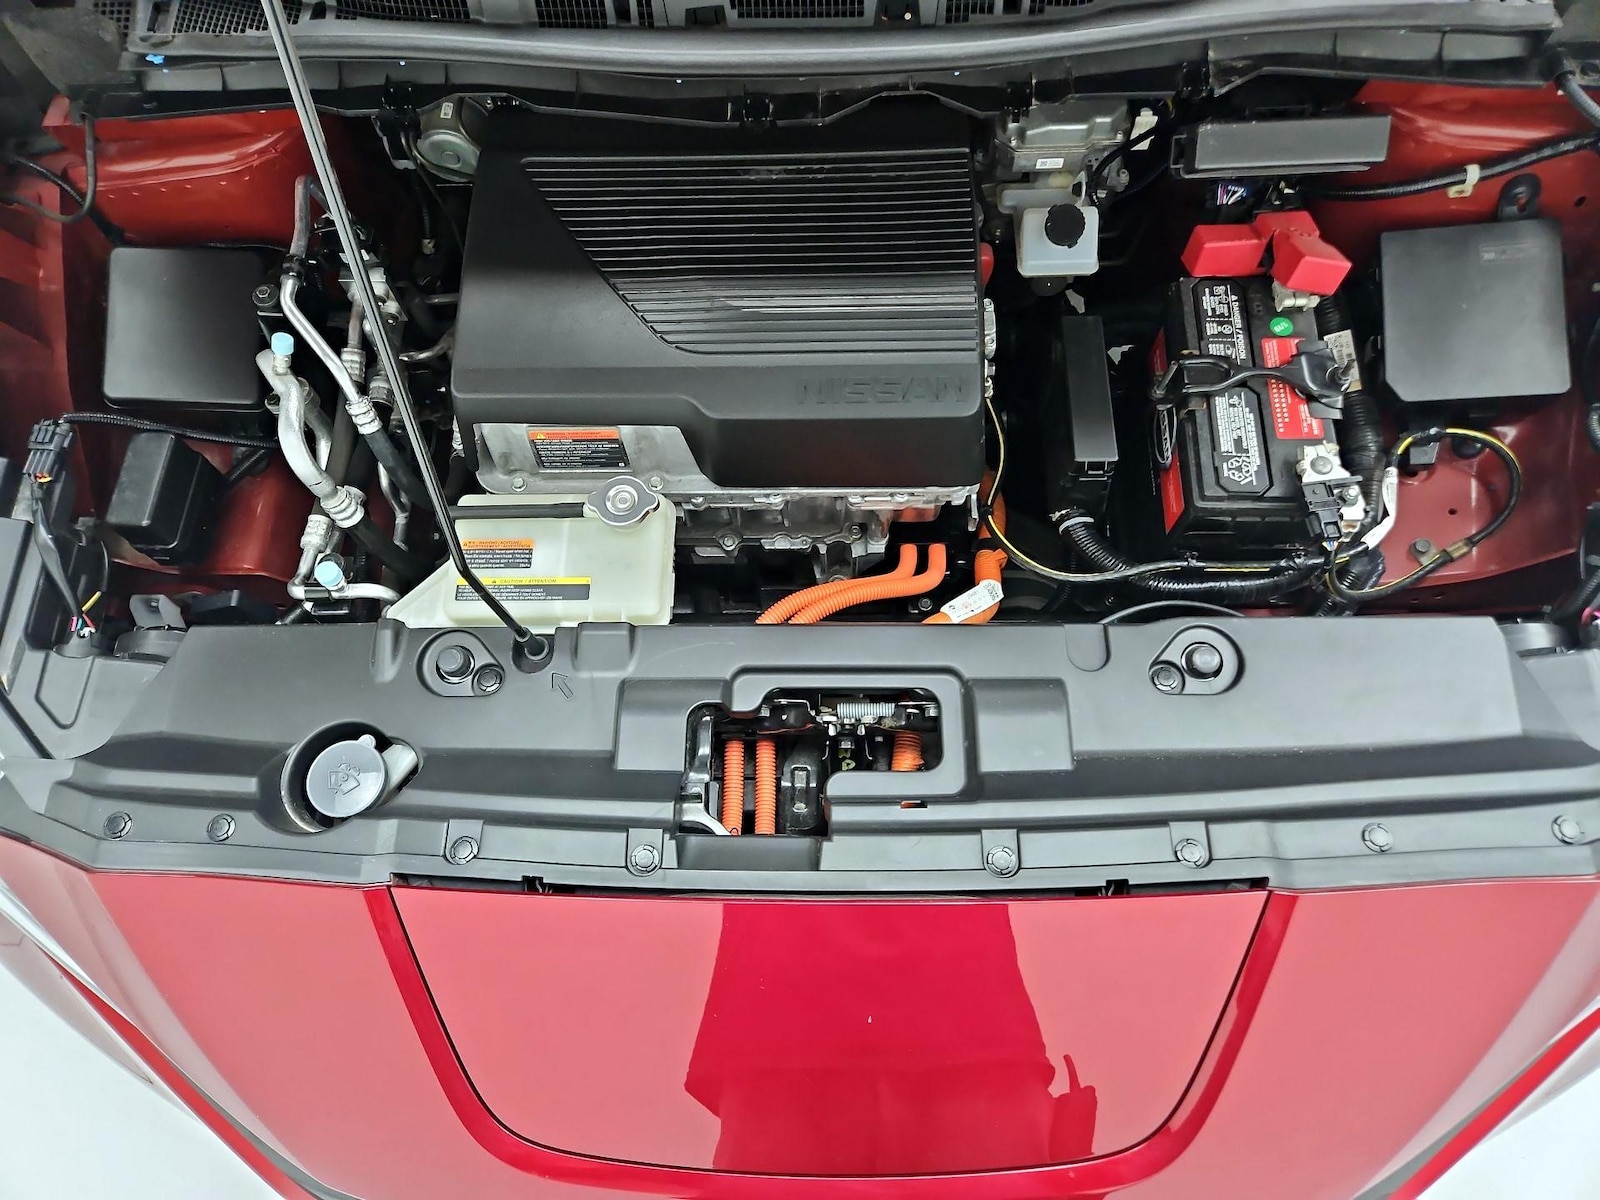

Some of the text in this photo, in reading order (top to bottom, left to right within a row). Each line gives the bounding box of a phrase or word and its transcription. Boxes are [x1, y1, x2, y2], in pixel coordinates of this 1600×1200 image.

[1232, 302, 1242, 329] DANGER
[1237, 334, 1246, 359] POISON
[799, 376, 968, 404] NISSAN
